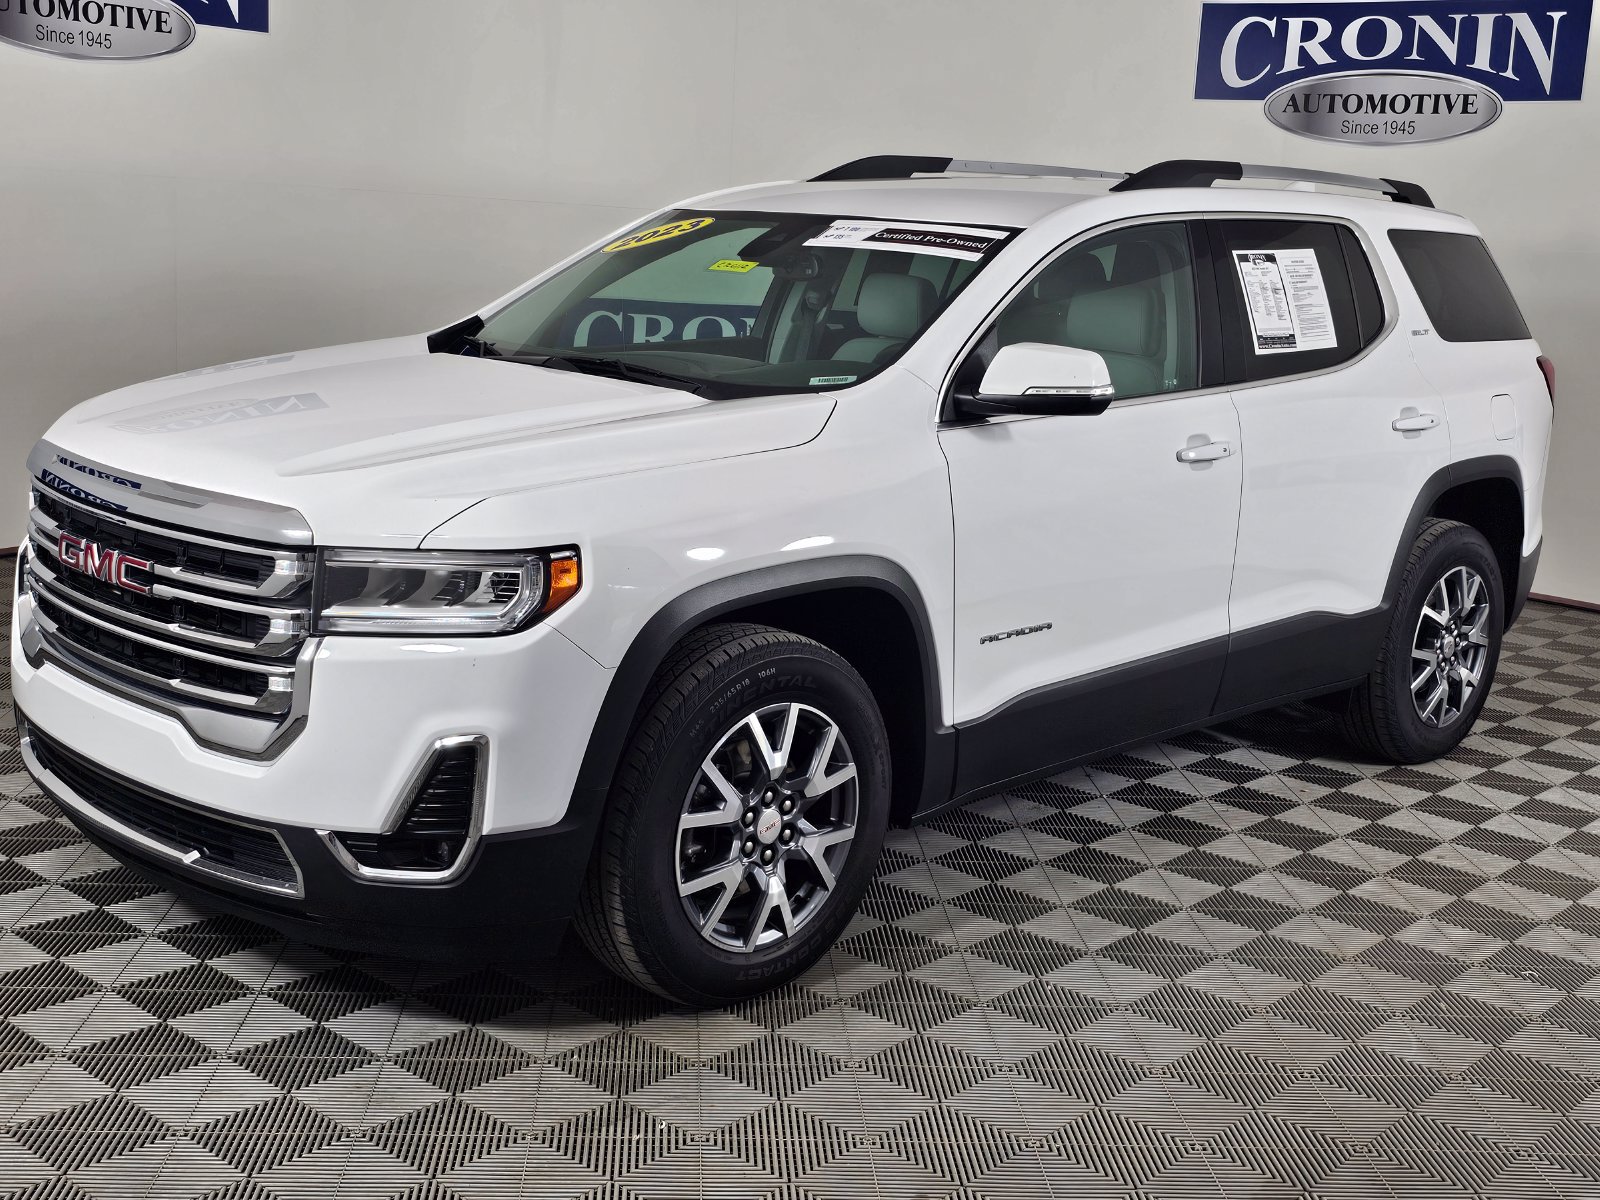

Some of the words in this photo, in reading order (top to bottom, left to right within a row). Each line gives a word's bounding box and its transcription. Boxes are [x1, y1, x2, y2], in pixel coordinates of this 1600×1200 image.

[35, 25, 76, 45] Since
[78, 30, 112, 49] 1945
[1220, 11, 1567, 95] CRONIN
[1283, 93, 1479, 115] AUTOMOTIVE
[1340, 119, 1379, 135] Since
[1382, 120, 1416, 135] 1945
[610, 219, 706, 250] 2023
[875, 230, 922, 242] Certified
[924, 235, 988, 249] Pre-Owned
[1411, 329, 1430, 337] SLT
[58, 529, 155, 595] GMC
[979, 621, 1053, 645] ACADIA
[758, 667, 776, 679] 106H
